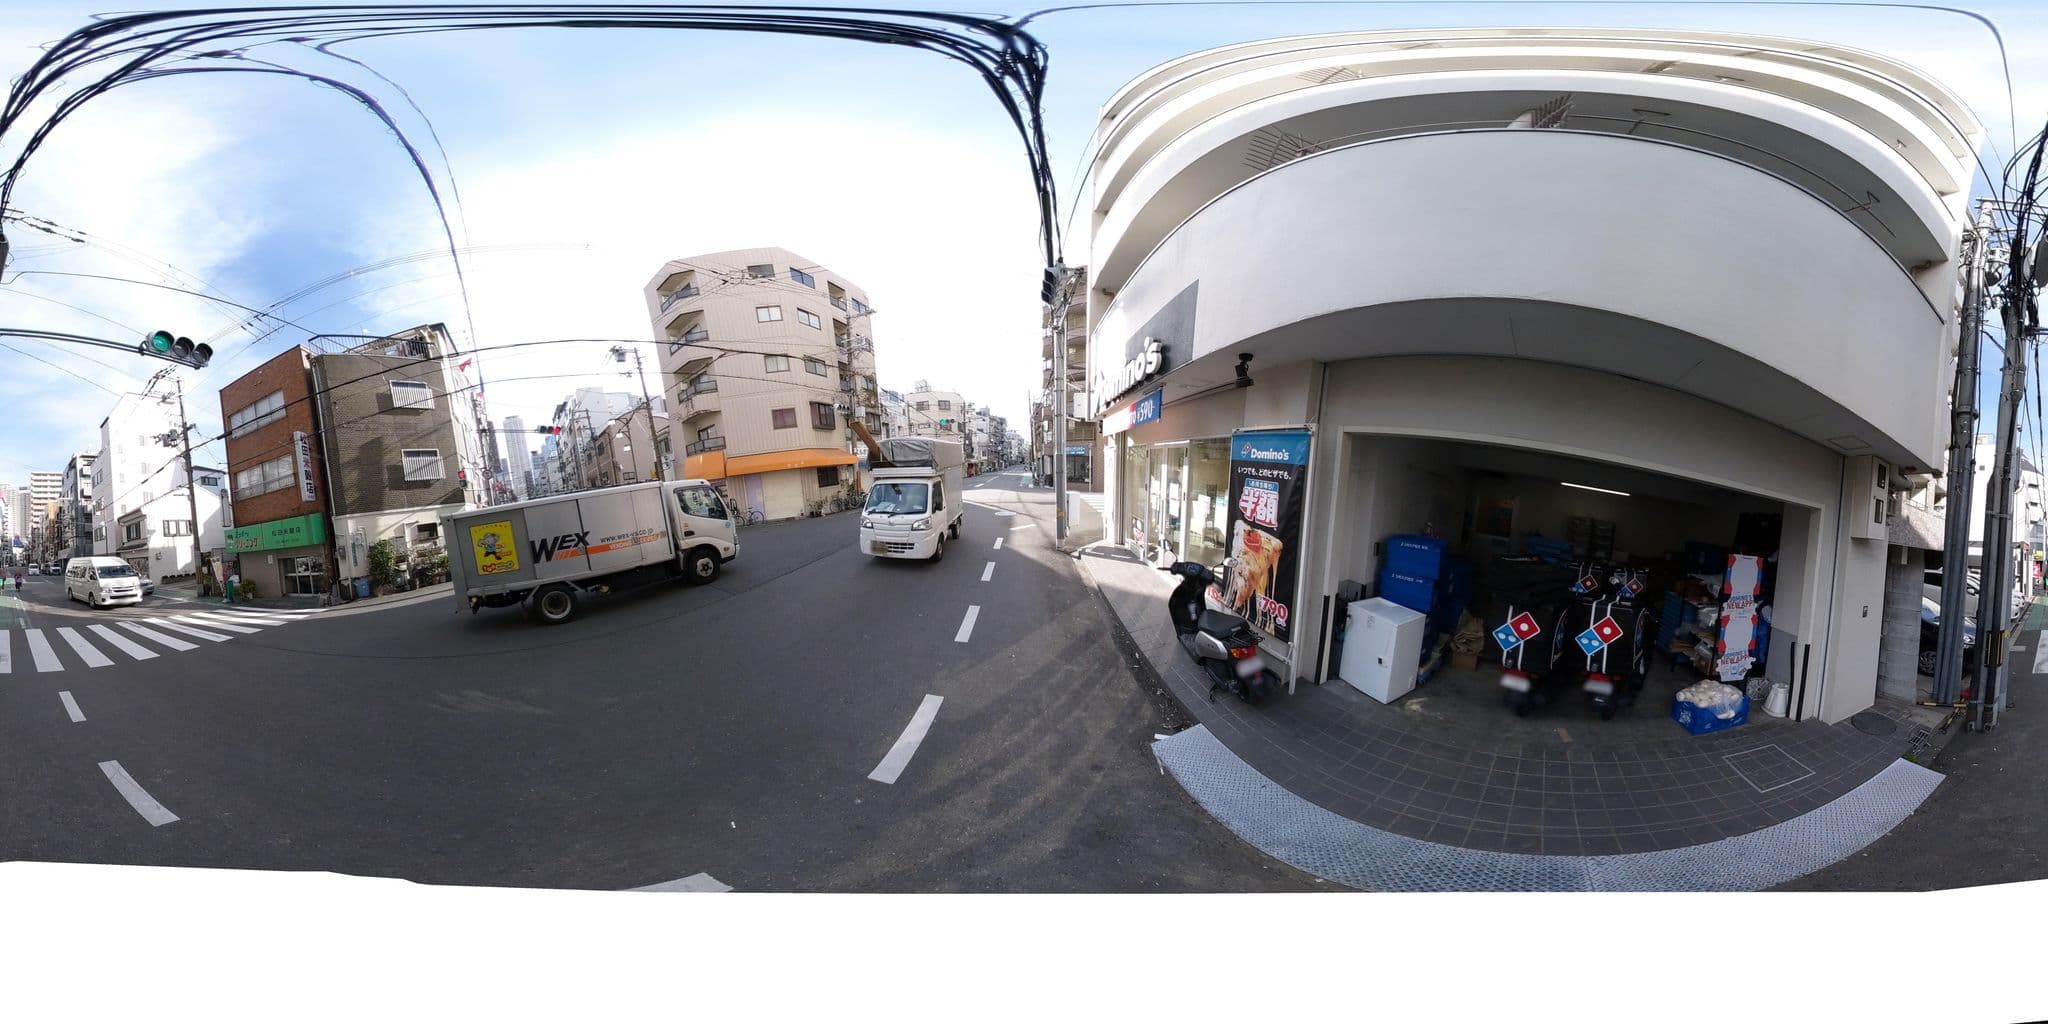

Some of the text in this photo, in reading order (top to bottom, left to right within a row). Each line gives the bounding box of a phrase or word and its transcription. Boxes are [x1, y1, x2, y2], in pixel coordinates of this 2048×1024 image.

[1250, 448, 1290, 460] Domino's
[1238, 466, 1292, 480] いつでも、どのピザでも。
[1239, 488, 1279, 527] 半額
[530, 531, 590, 563] WEX
